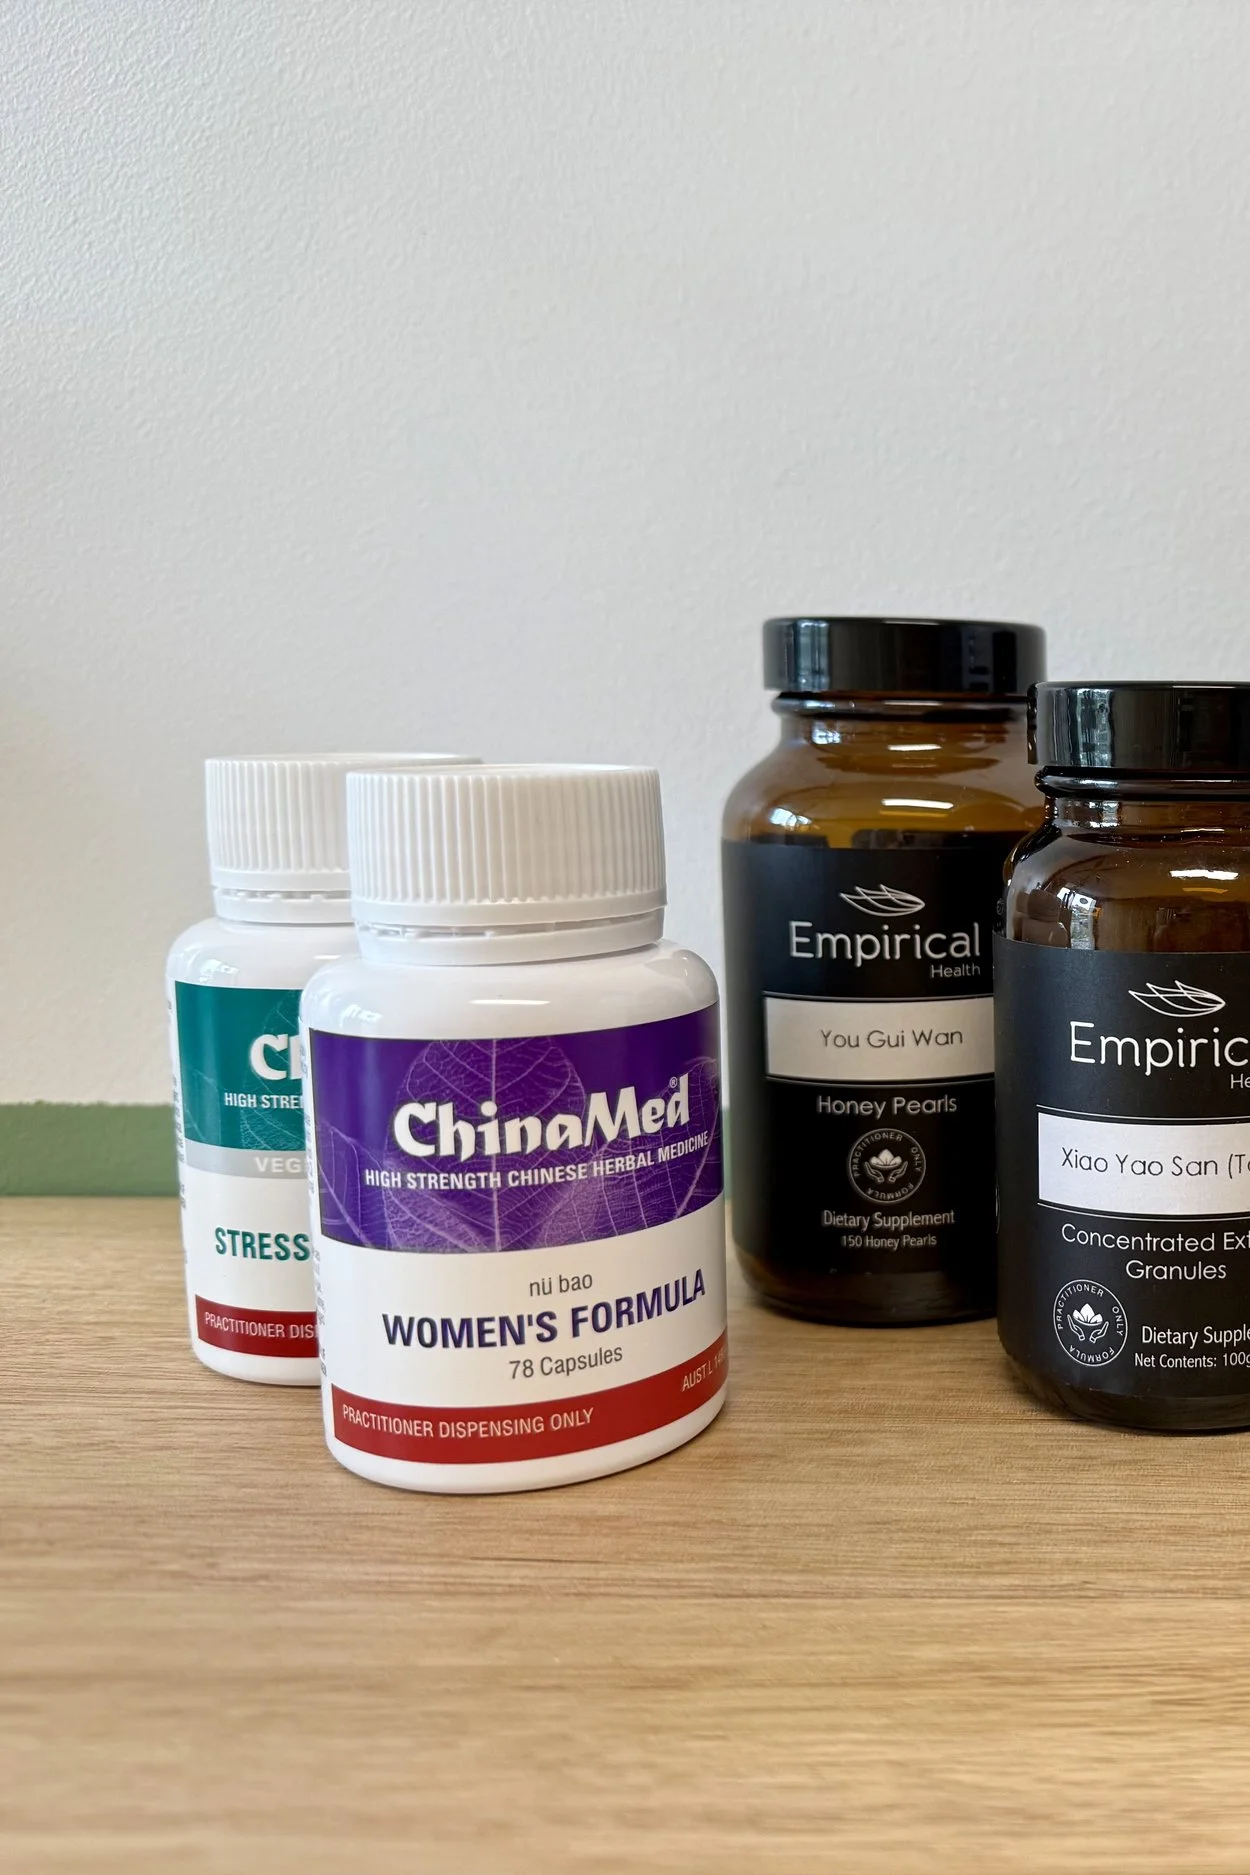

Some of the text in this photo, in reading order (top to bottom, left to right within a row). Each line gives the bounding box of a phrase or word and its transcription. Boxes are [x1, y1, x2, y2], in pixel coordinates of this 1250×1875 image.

[788, 920, 980, 967] Empirical
[930, 963, 981, 978] Health
[820, 1029, 964, 1049] You Gui Wan
[224, 1092, 303, 1109] HIGH STRE
[817, 1095, 958, 1119] Honey Pearls
[365, 1130, 709, 1190] HIGH STRENGTH CHINESE HERBAL MEDICINE
[1061, 1147, 1108, 1173] Xiao
[1116, 1154, 1164, 1176] Yao
[1171, 1155, 1219, 1176] San
[823, 1210, 955, 1233] Dietary Supplement
[215, 1227, 311, 1261] STRESS
[841, 1234, 938, 1251] 150 Honey Pearls
[1061, 1223, 1215, 1252] Concentrated
[1126, 1259, 1227, 1280] Granules
[529, 1273, 593, 1297] nü bao
[381, 1268, 706, 1349] WOMEN'S FORMULA
[1056, 1284, 1124, 1336] PRACTITIONER ONLY
[204, 1311, 317, 1339] PRACTITIONER DIS
[1141, 1325, 1198, 1349] Dietary
[509, 1344, 623, 1380] 78 Capsules
[1069, 1345, 1115, 1362] FORMULA
[1134, 1353, 1155, 1368] Net
[1157, 1353, 1217, 1368] Contents:
[682, 1361, 707, 1392] AUST
[342, 1404, 594, 1438] PRACTITIONER DISPENSING ONLY
